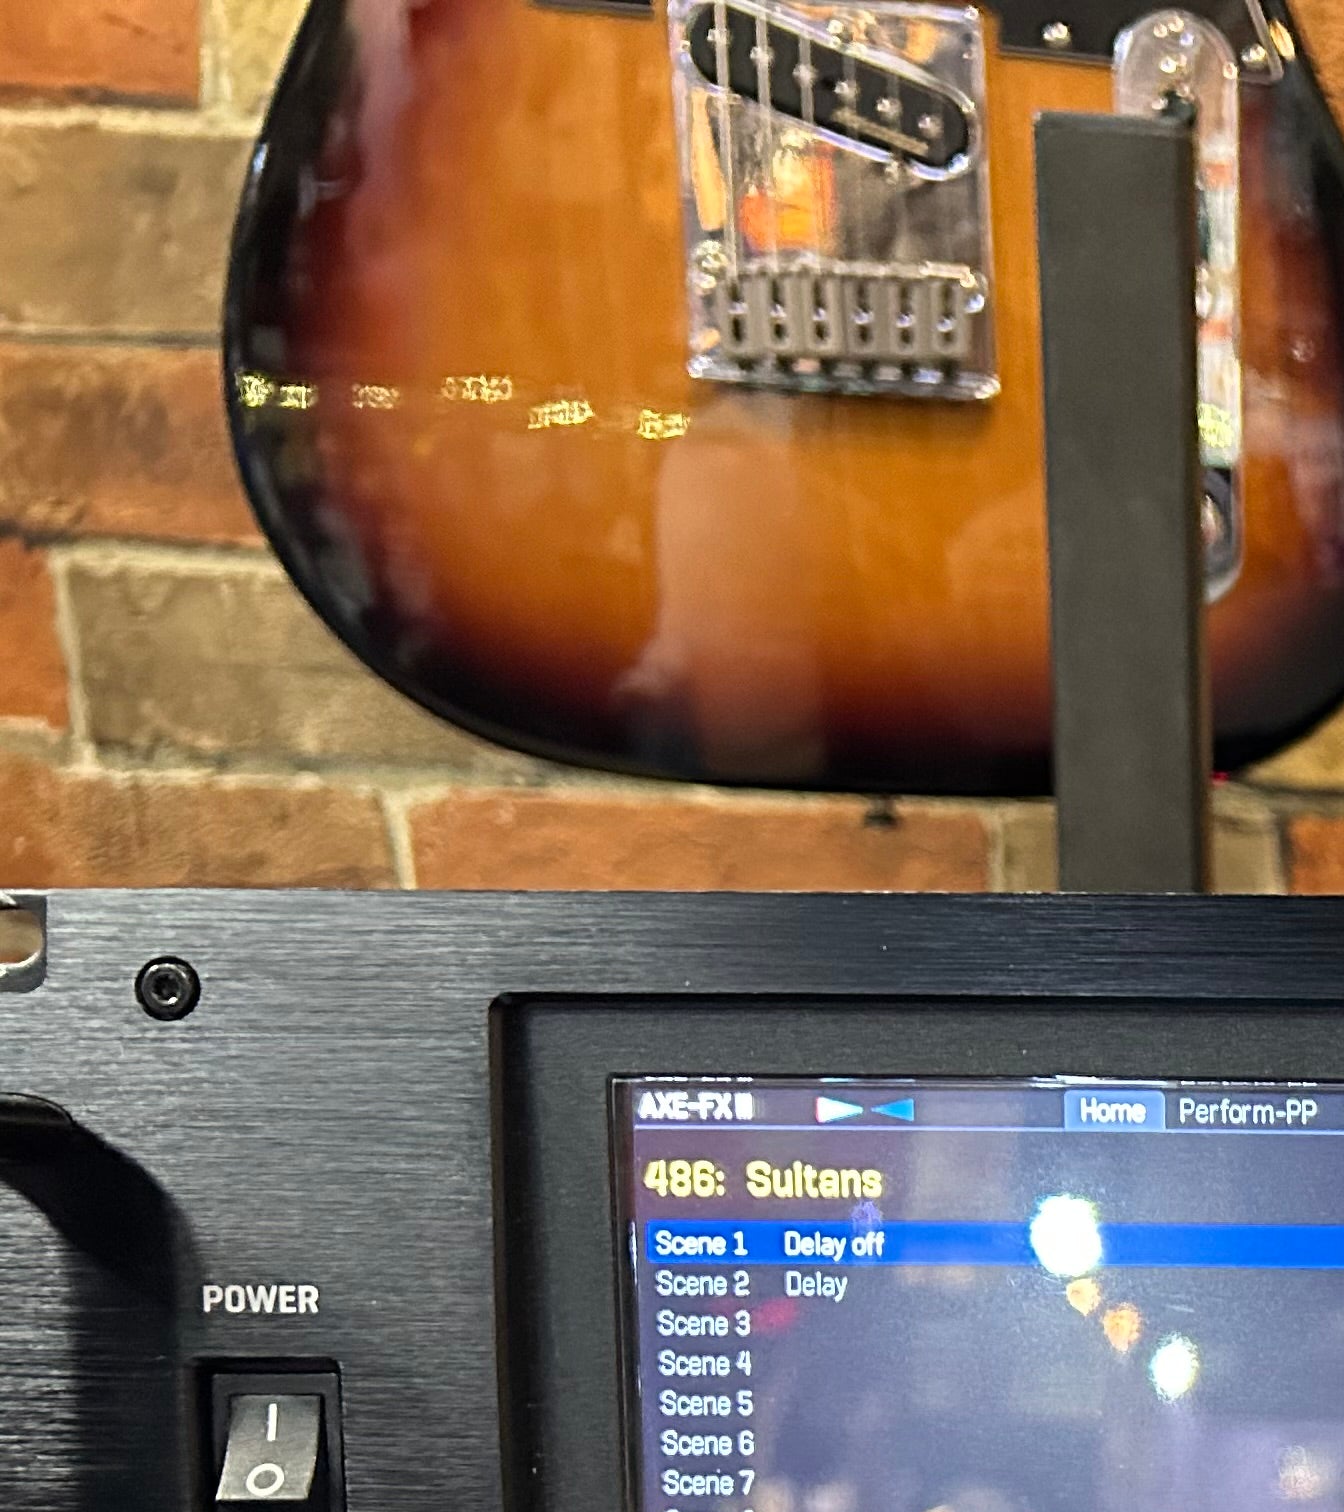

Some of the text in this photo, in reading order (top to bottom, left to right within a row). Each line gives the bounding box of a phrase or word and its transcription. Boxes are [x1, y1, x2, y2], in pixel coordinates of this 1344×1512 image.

[1080, 1099, 1147, 1124] Home
[1178, 1099, 1319, 1126] Perform-PP
[643, 1159, 883, 1198] 486: Sultans
[655, 1230, 885, 1262] Scene 1 Delay off
[203, 1284, 320, 1314] POWER
[656, 1270, 848, 1302] Scene 2 Delay
[657, 1309, 751, 1336] Scene 3
[658, 1349, 752, 1377] Scene 4
[659, 1389, 754, 1417] Scene 5
[660, 1429, 755, 1456] Scene 6
[661, 1469, 755, 1496] Scene 7
